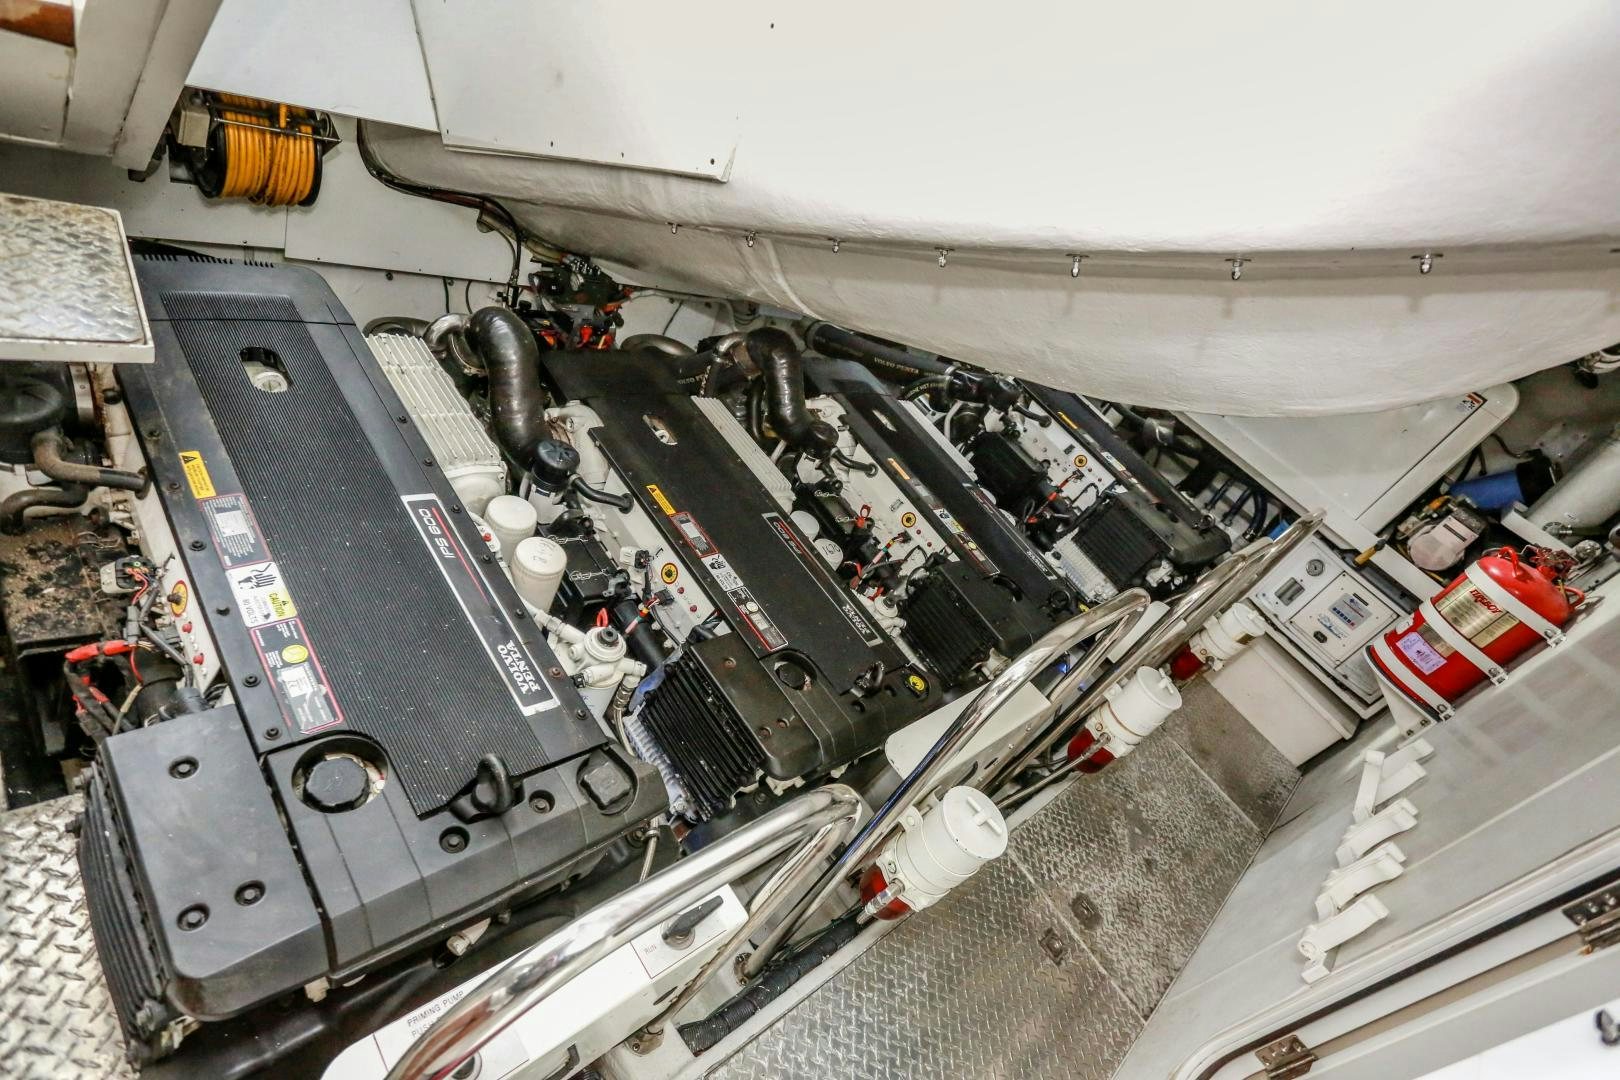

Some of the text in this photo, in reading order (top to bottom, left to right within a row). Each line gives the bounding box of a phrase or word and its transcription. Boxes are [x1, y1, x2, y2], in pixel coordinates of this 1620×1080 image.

[418, 508, 456, 559] IPS 600
[268, 592, 286, 617] CAUTION
[497, 644, 530, 695] VOLVO
[506, 640, 541, 692] PENTA
[407, 990, 464, 1028] PRIMING PUMP
